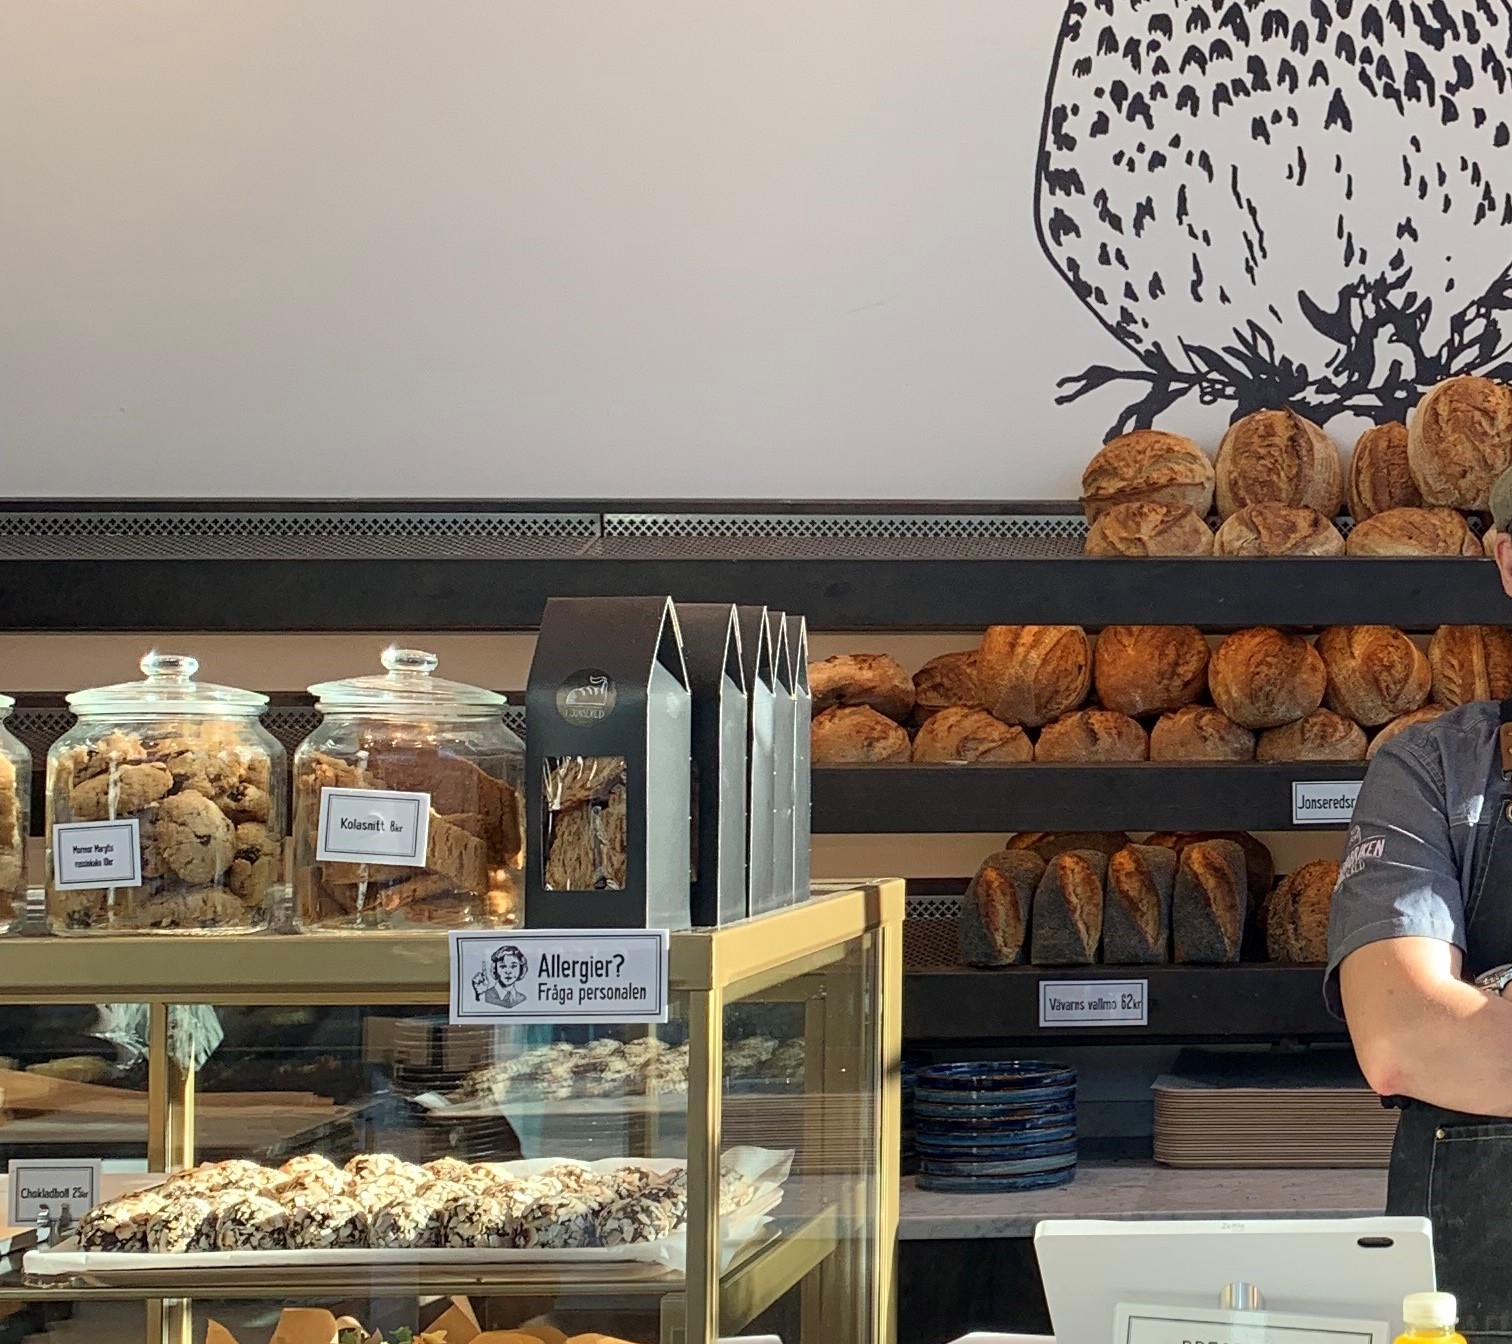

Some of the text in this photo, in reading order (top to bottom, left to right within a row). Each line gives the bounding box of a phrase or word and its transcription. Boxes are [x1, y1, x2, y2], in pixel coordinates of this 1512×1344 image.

[1297, 794, 1356, 810] Jonseredsr
[340, 817, 404, 833] Kolasnitt 8kr
[537, 952, 626, 985] Allergier?
[537, 981, 647, 1006] Fråga personalen
[1048, 993, 1142, 1012] Vävarns vallmo 62kr
[20, 1187, 70, 1199] Chokladboll
